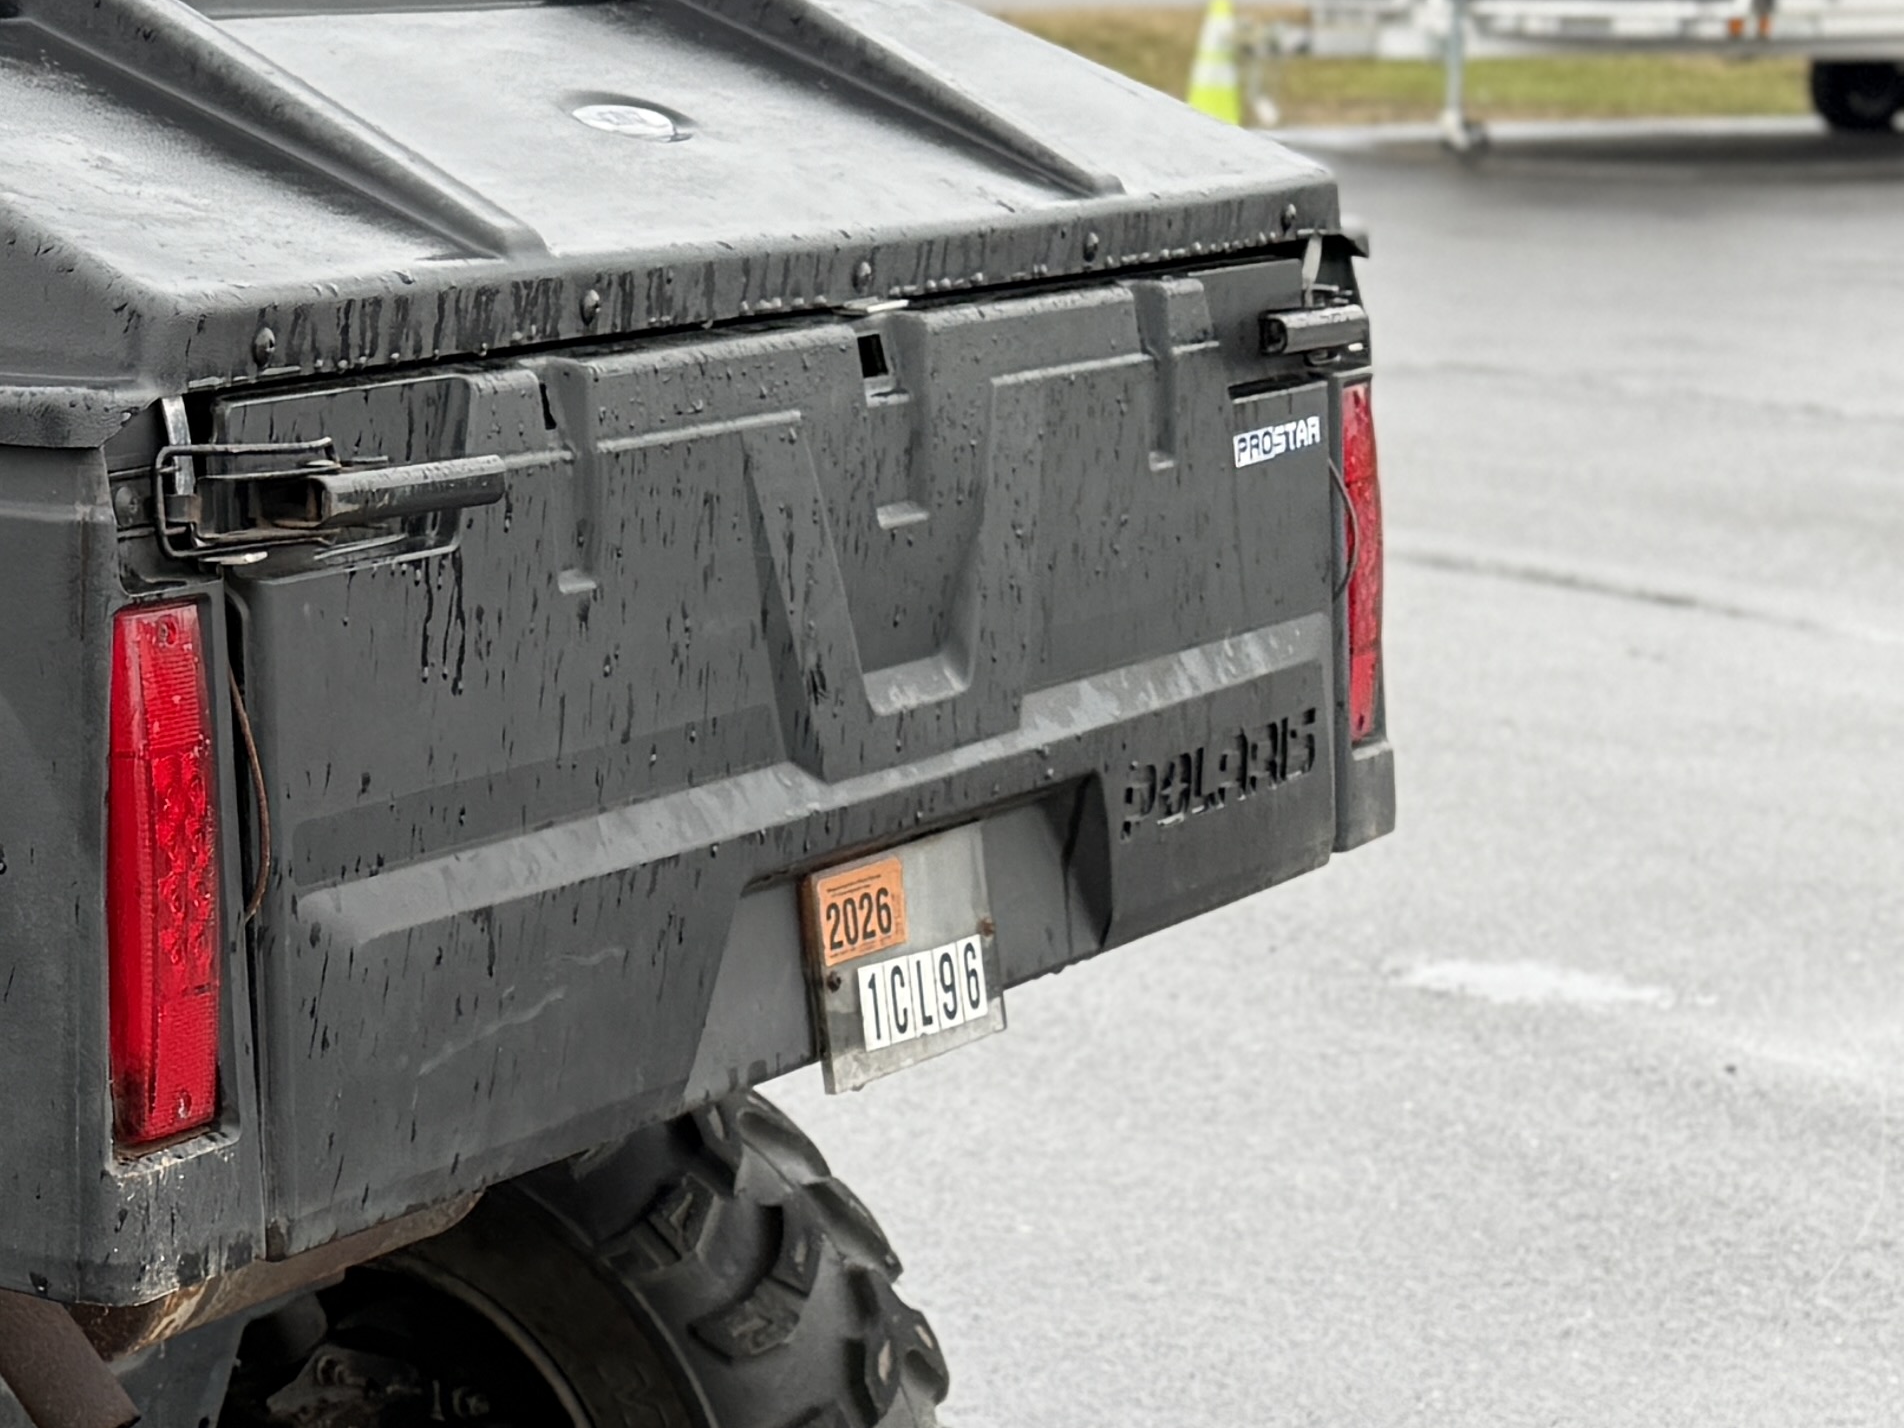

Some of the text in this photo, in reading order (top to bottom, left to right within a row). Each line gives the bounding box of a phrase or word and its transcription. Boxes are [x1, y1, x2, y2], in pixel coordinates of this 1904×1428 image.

[1234, 416, 1320, 467] PROSTAR
[1120, 707, 1317, 842] POLARIS
[826, 887, 892, 951] 2026
[868, 942, 980, 1041] 1CL96
